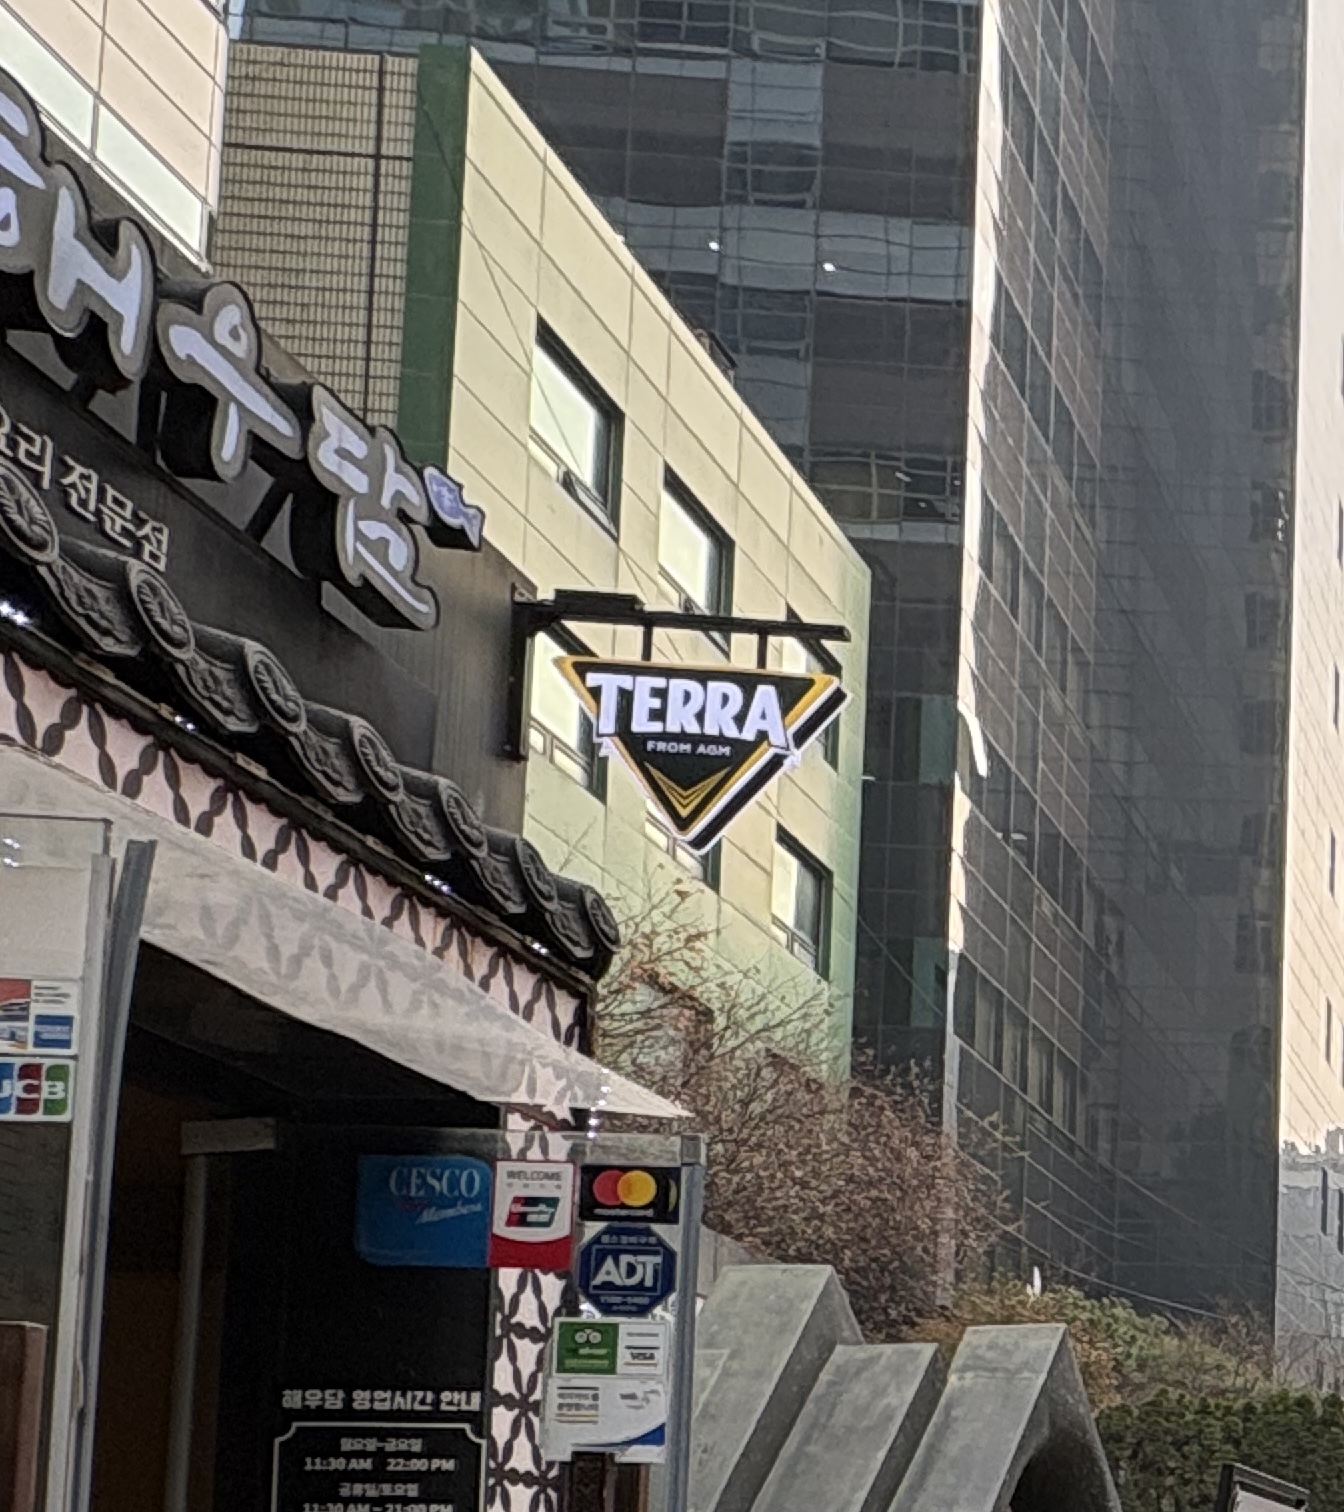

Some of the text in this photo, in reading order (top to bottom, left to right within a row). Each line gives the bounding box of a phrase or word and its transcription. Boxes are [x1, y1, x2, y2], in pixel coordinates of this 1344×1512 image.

[59, 455, 169, 572] 전문점
[585, 672, 788, 748] TERRA
[647, 741, 692, 754] FROM
[0, 1079, 66, 1100] JCB
[388, 1166, 480, 1198] CESCO
[506, 1169, 562, 1183] WELCOME
[591, 1254, 662, 1288] ADT
[282, 1389, 482, 1412] 해우담 영업시간 안내
[304, 1457, 455, 1471] 11:30 AM 22:00 PM
